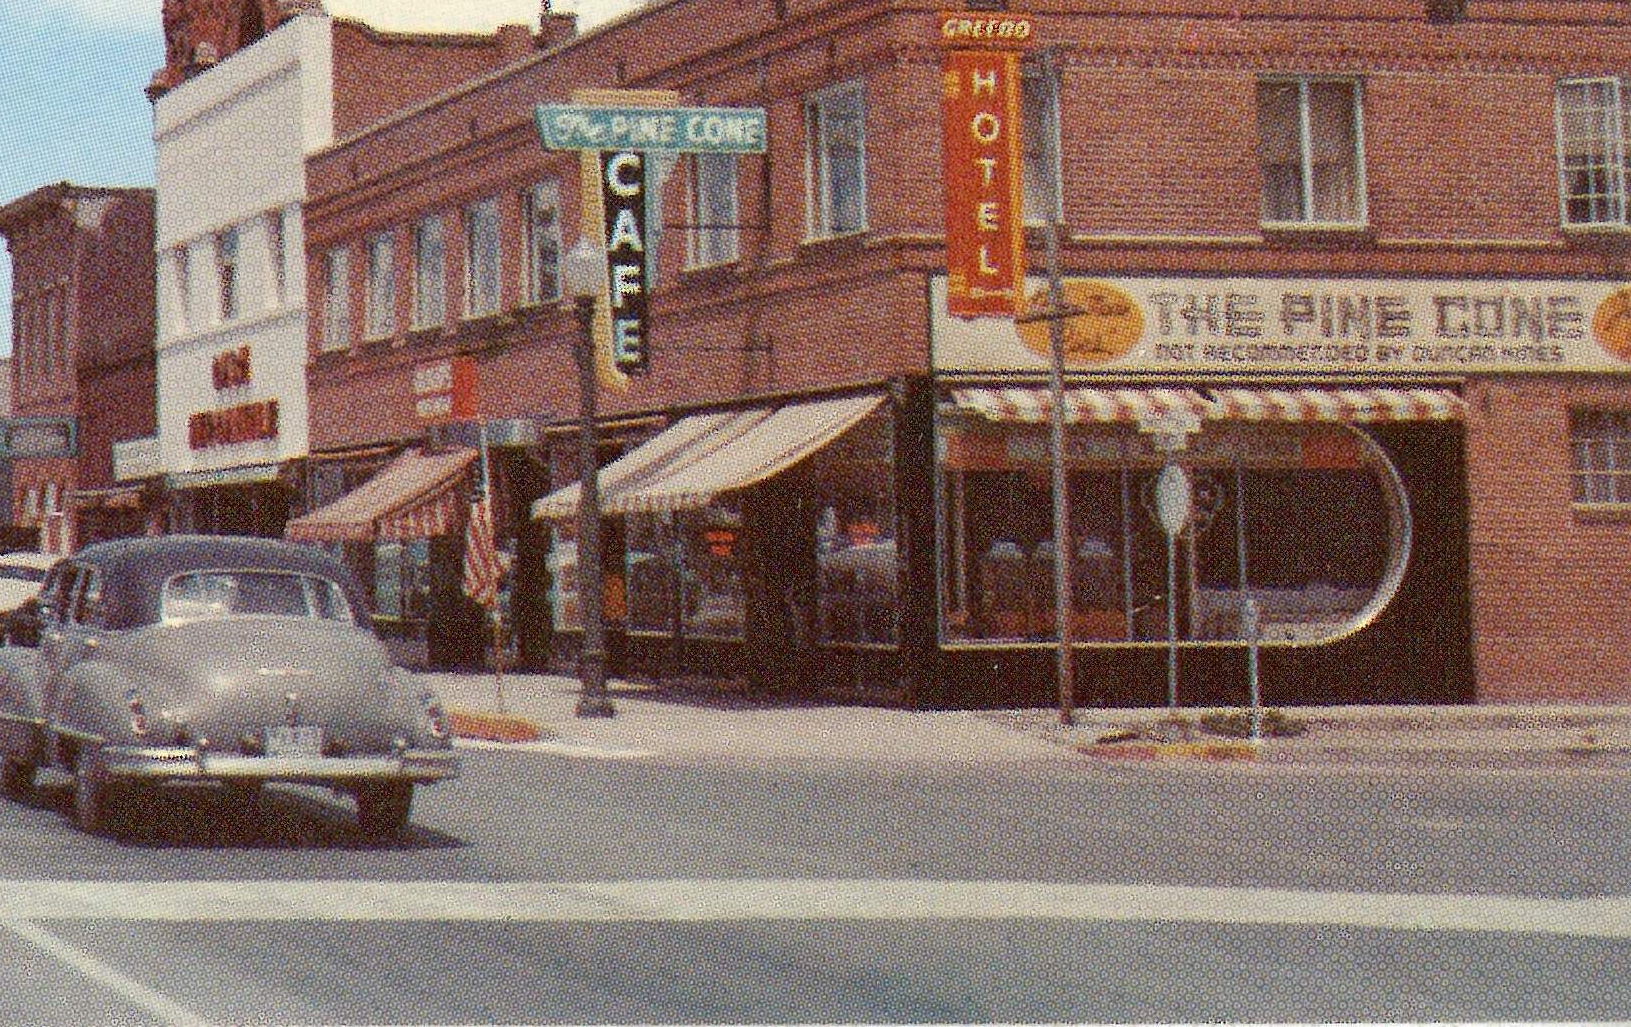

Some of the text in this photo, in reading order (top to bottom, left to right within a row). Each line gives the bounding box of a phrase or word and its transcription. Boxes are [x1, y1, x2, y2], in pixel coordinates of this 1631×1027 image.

[611, 114, 677, 143] PINE
[687, 114, 762, 144] CONE
[972, 70, 1000, 274] HOTEL
[606, 152, 644, 364] CAFE
[1148, 292, 1266, 338] THE
[1279, 292, 1411, 340] PINE
[1433, 294, 1584, 342] CONE
[1155, 342, 1196, 361] NOT
[1203, 343, 1370, 363] RECOMMENDED
[1375, 345, 1403, 362] BY
